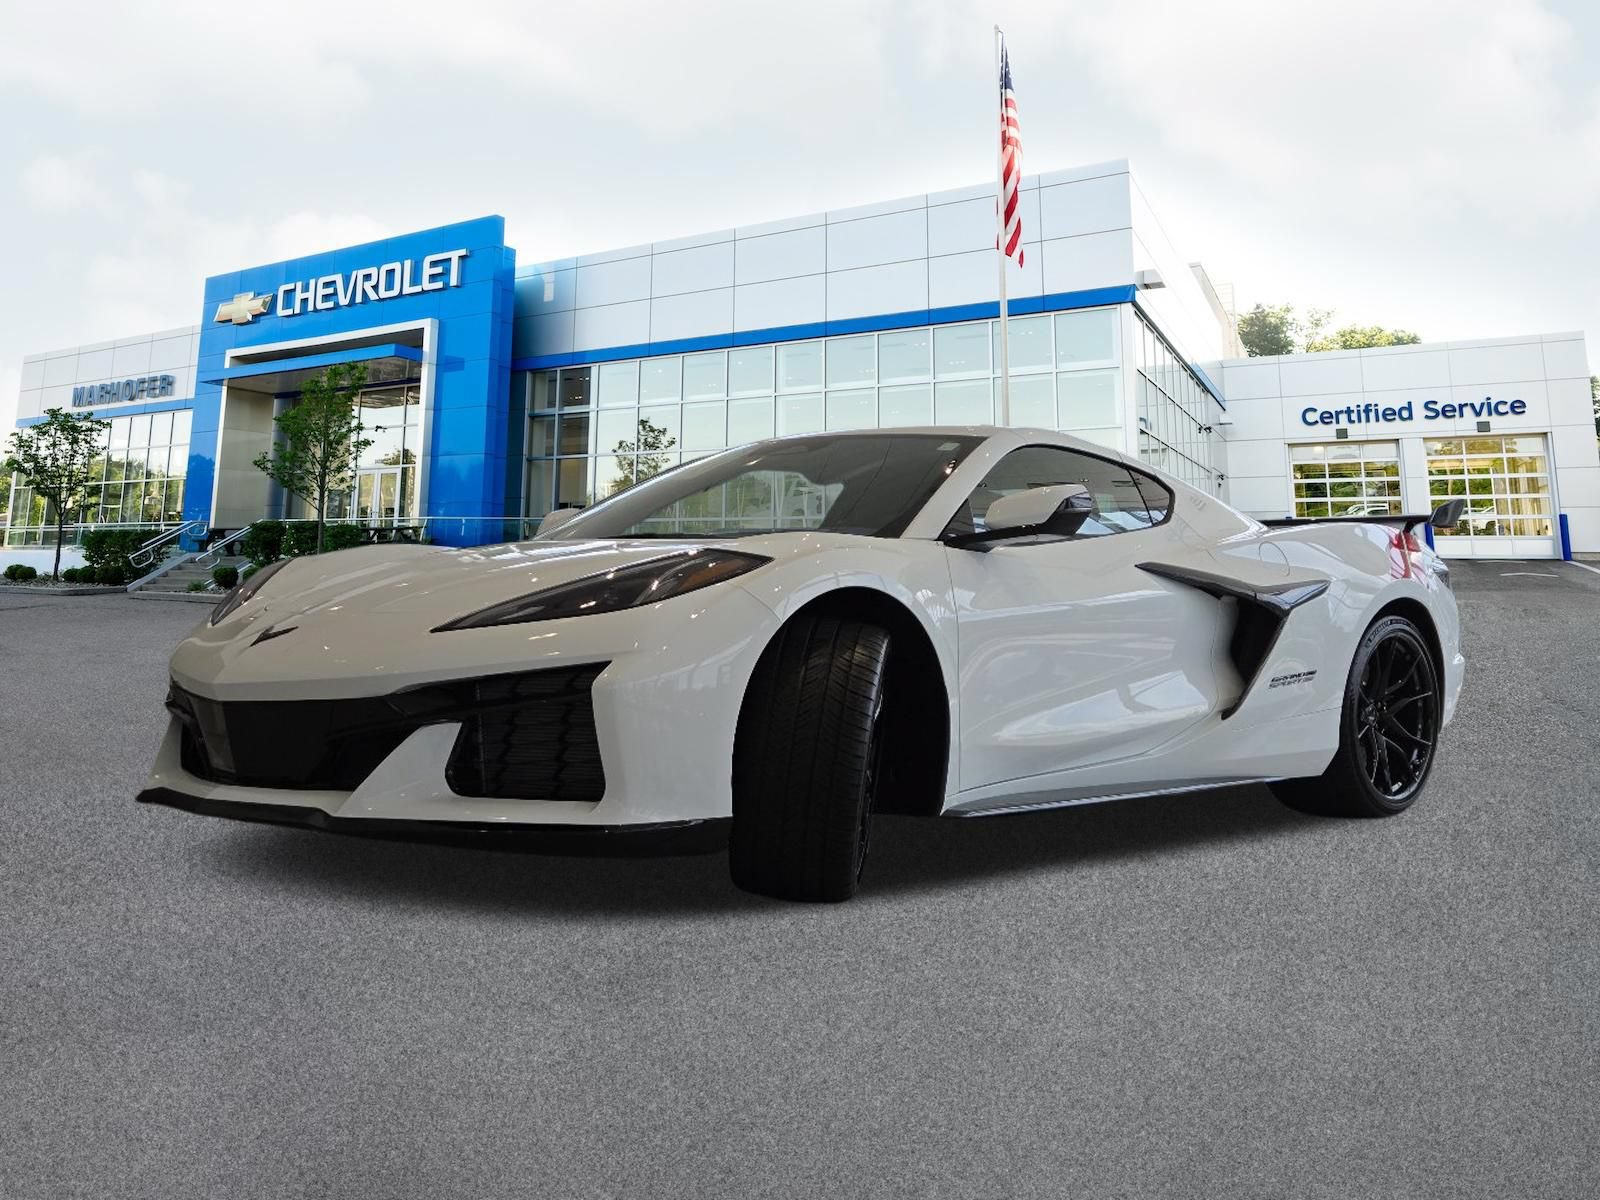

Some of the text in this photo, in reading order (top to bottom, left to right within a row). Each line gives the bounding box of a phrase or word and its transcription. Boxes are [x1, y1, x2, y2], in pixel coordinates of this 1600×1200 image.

[276, 248, 469, 317] CHEVROLET
[72, 374, 175, 407] MARHOFER
[1301, 396, 1528, 427] Certified Service
